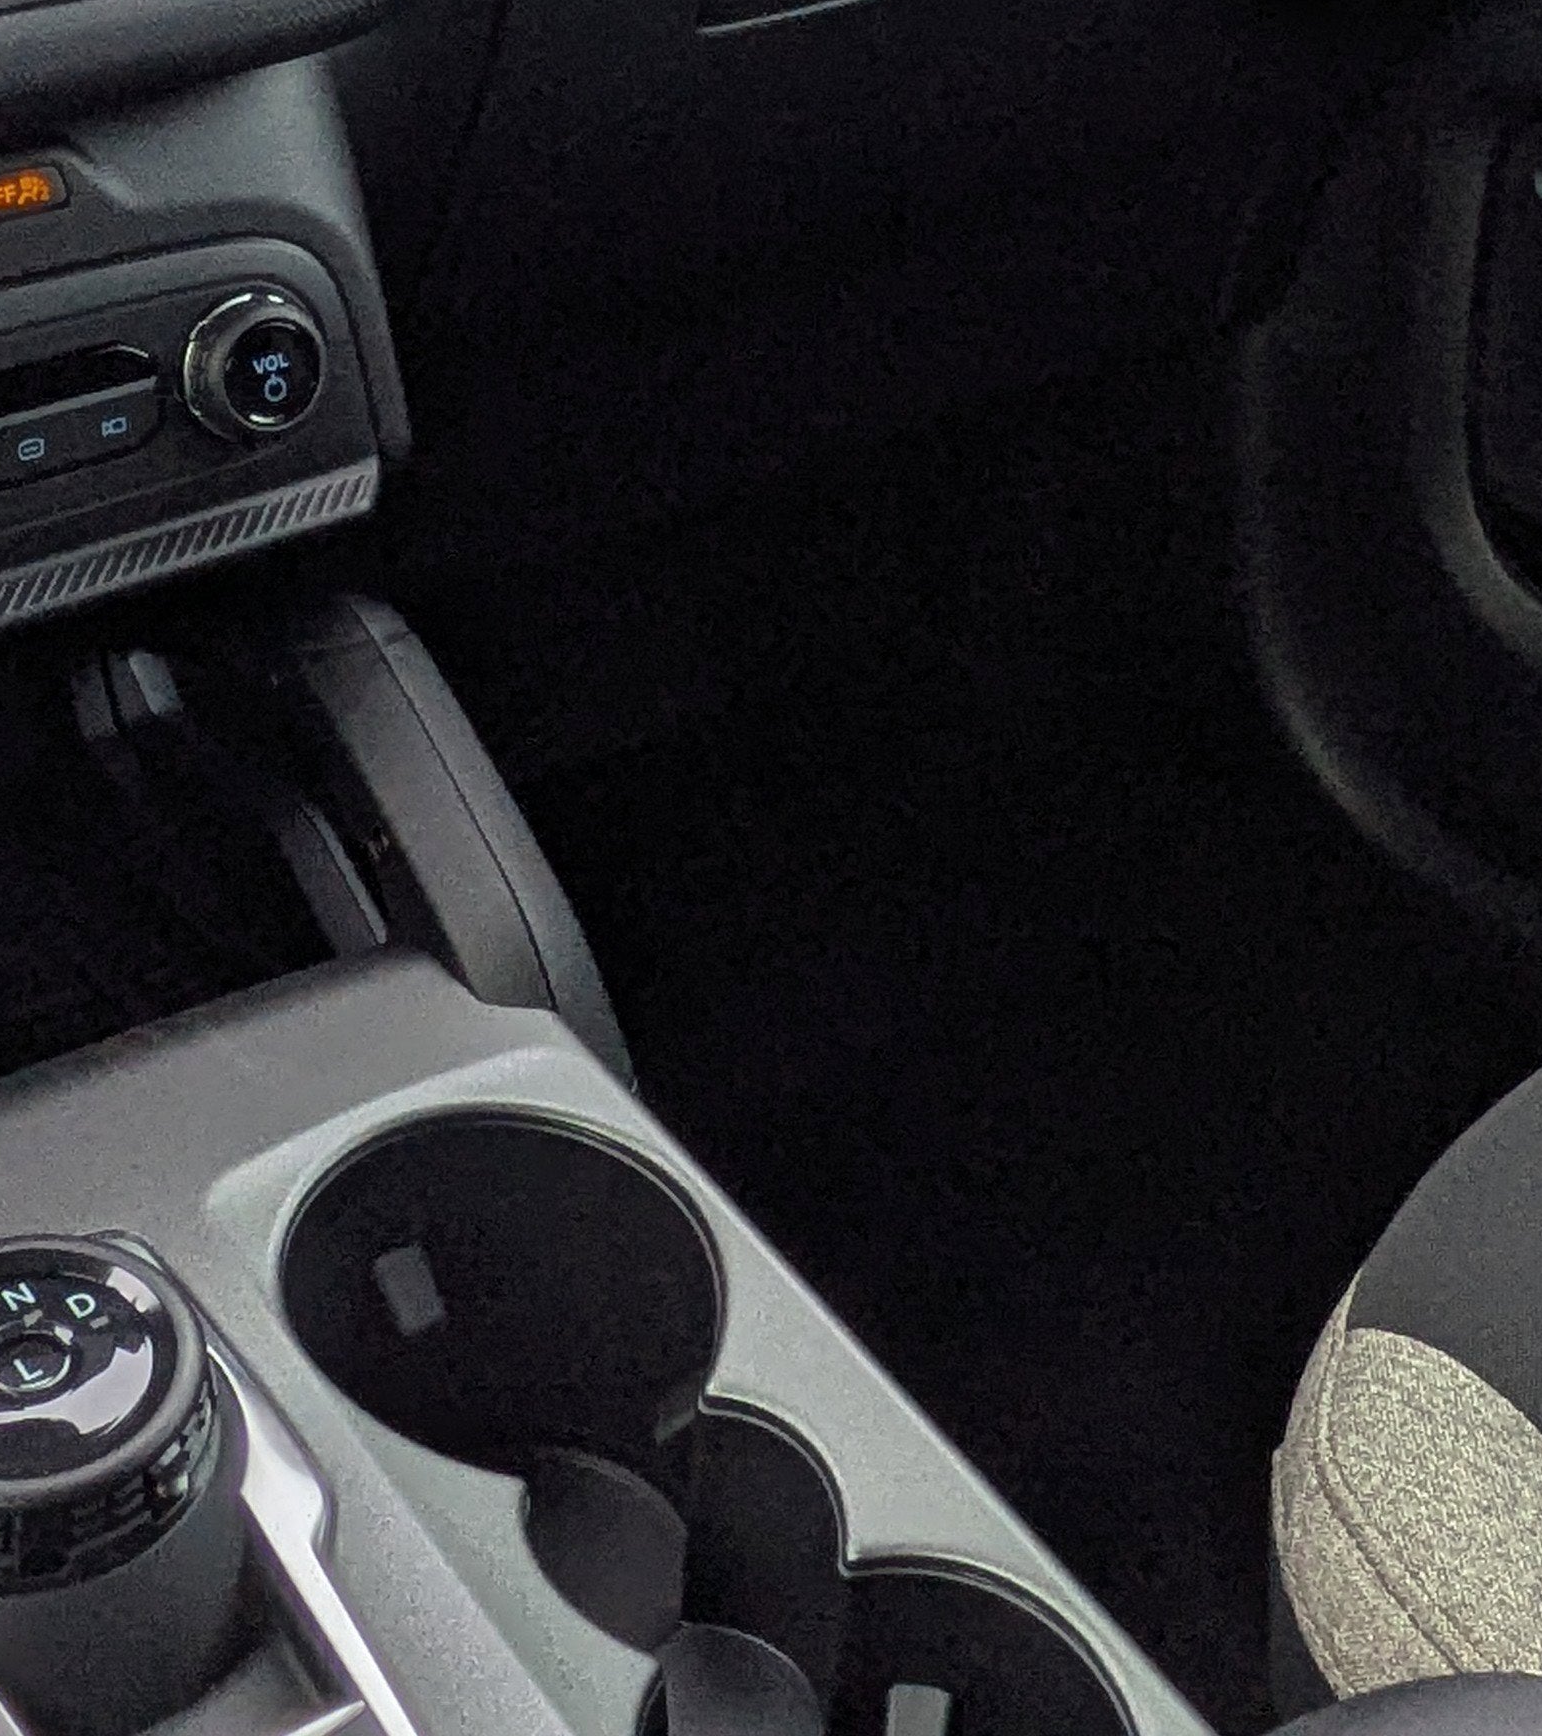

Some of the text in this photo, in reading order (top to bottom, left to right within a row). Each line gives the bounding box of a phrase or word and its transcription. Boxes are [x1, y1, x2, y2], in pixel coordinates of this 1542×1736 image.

[252, 353, 290, 374] VOL
[0, 1282, 36, 1311] N
[65, 1293, 96, 1318] D
[13, 1359, 44, 1381] L
